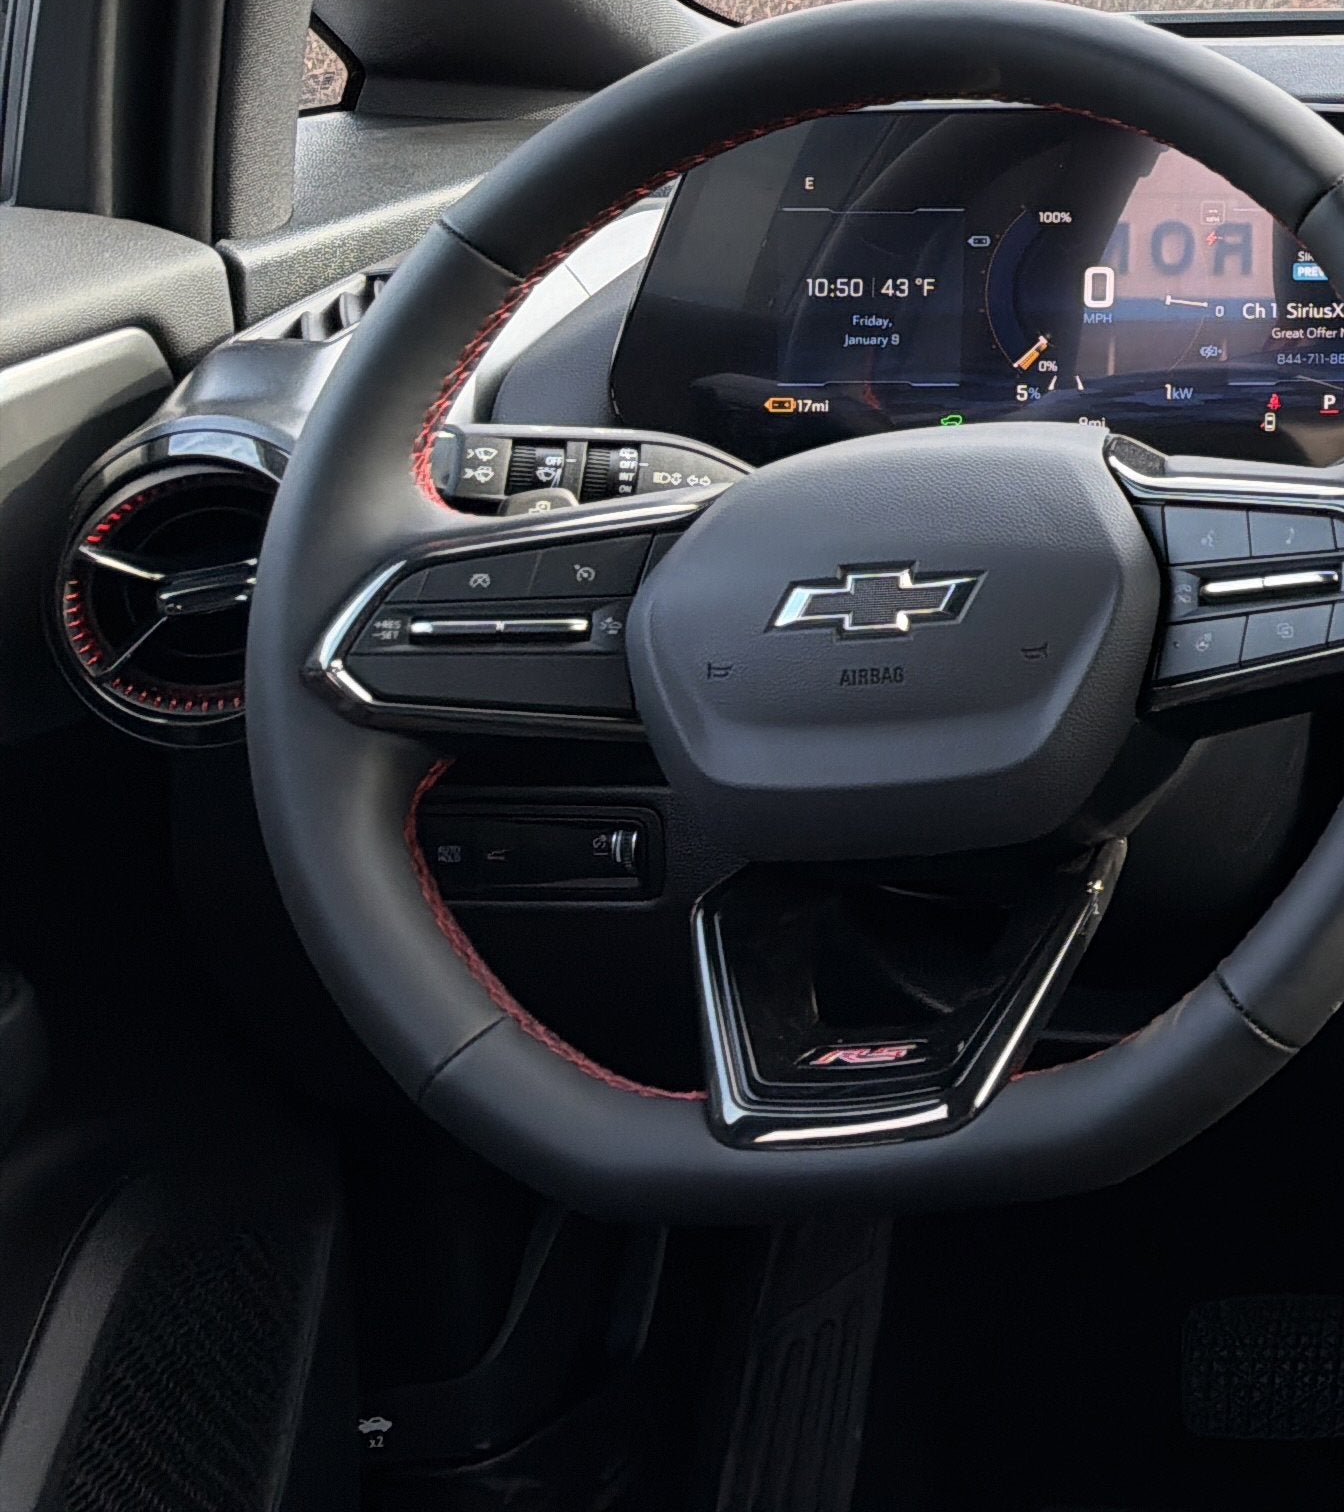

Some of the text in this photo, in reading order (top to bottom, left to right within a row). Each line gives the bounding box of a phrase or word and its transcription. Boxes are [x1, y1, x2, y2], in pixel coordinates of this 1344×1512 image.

[804, 176, 815, 191] E
[1038, 211, 1072, 224] 100%
[805, 277, 936, 297] 10:50 43 °F
[1083, 266, 1115, 308] 0
[1083, 313, 1113, 324] MPH
[1242, 303, 1265, 319] Ch
[1270, 303, 1278, 319] 1
[852, 314, 894, 329] Friday,
[1271, 327, 1304, 340] Great
[1306, 326, 1338, 339] Offer
[843, 334, 901, 348] January 9
[1038, 360, 1058, 372] 0%
[1016, 384, 1041, 401] 5%
[797, 399, 830, 412] 17mi
[1322, 395, 1336, 410] P
[838, 666, 905, 687] AIRBAG
